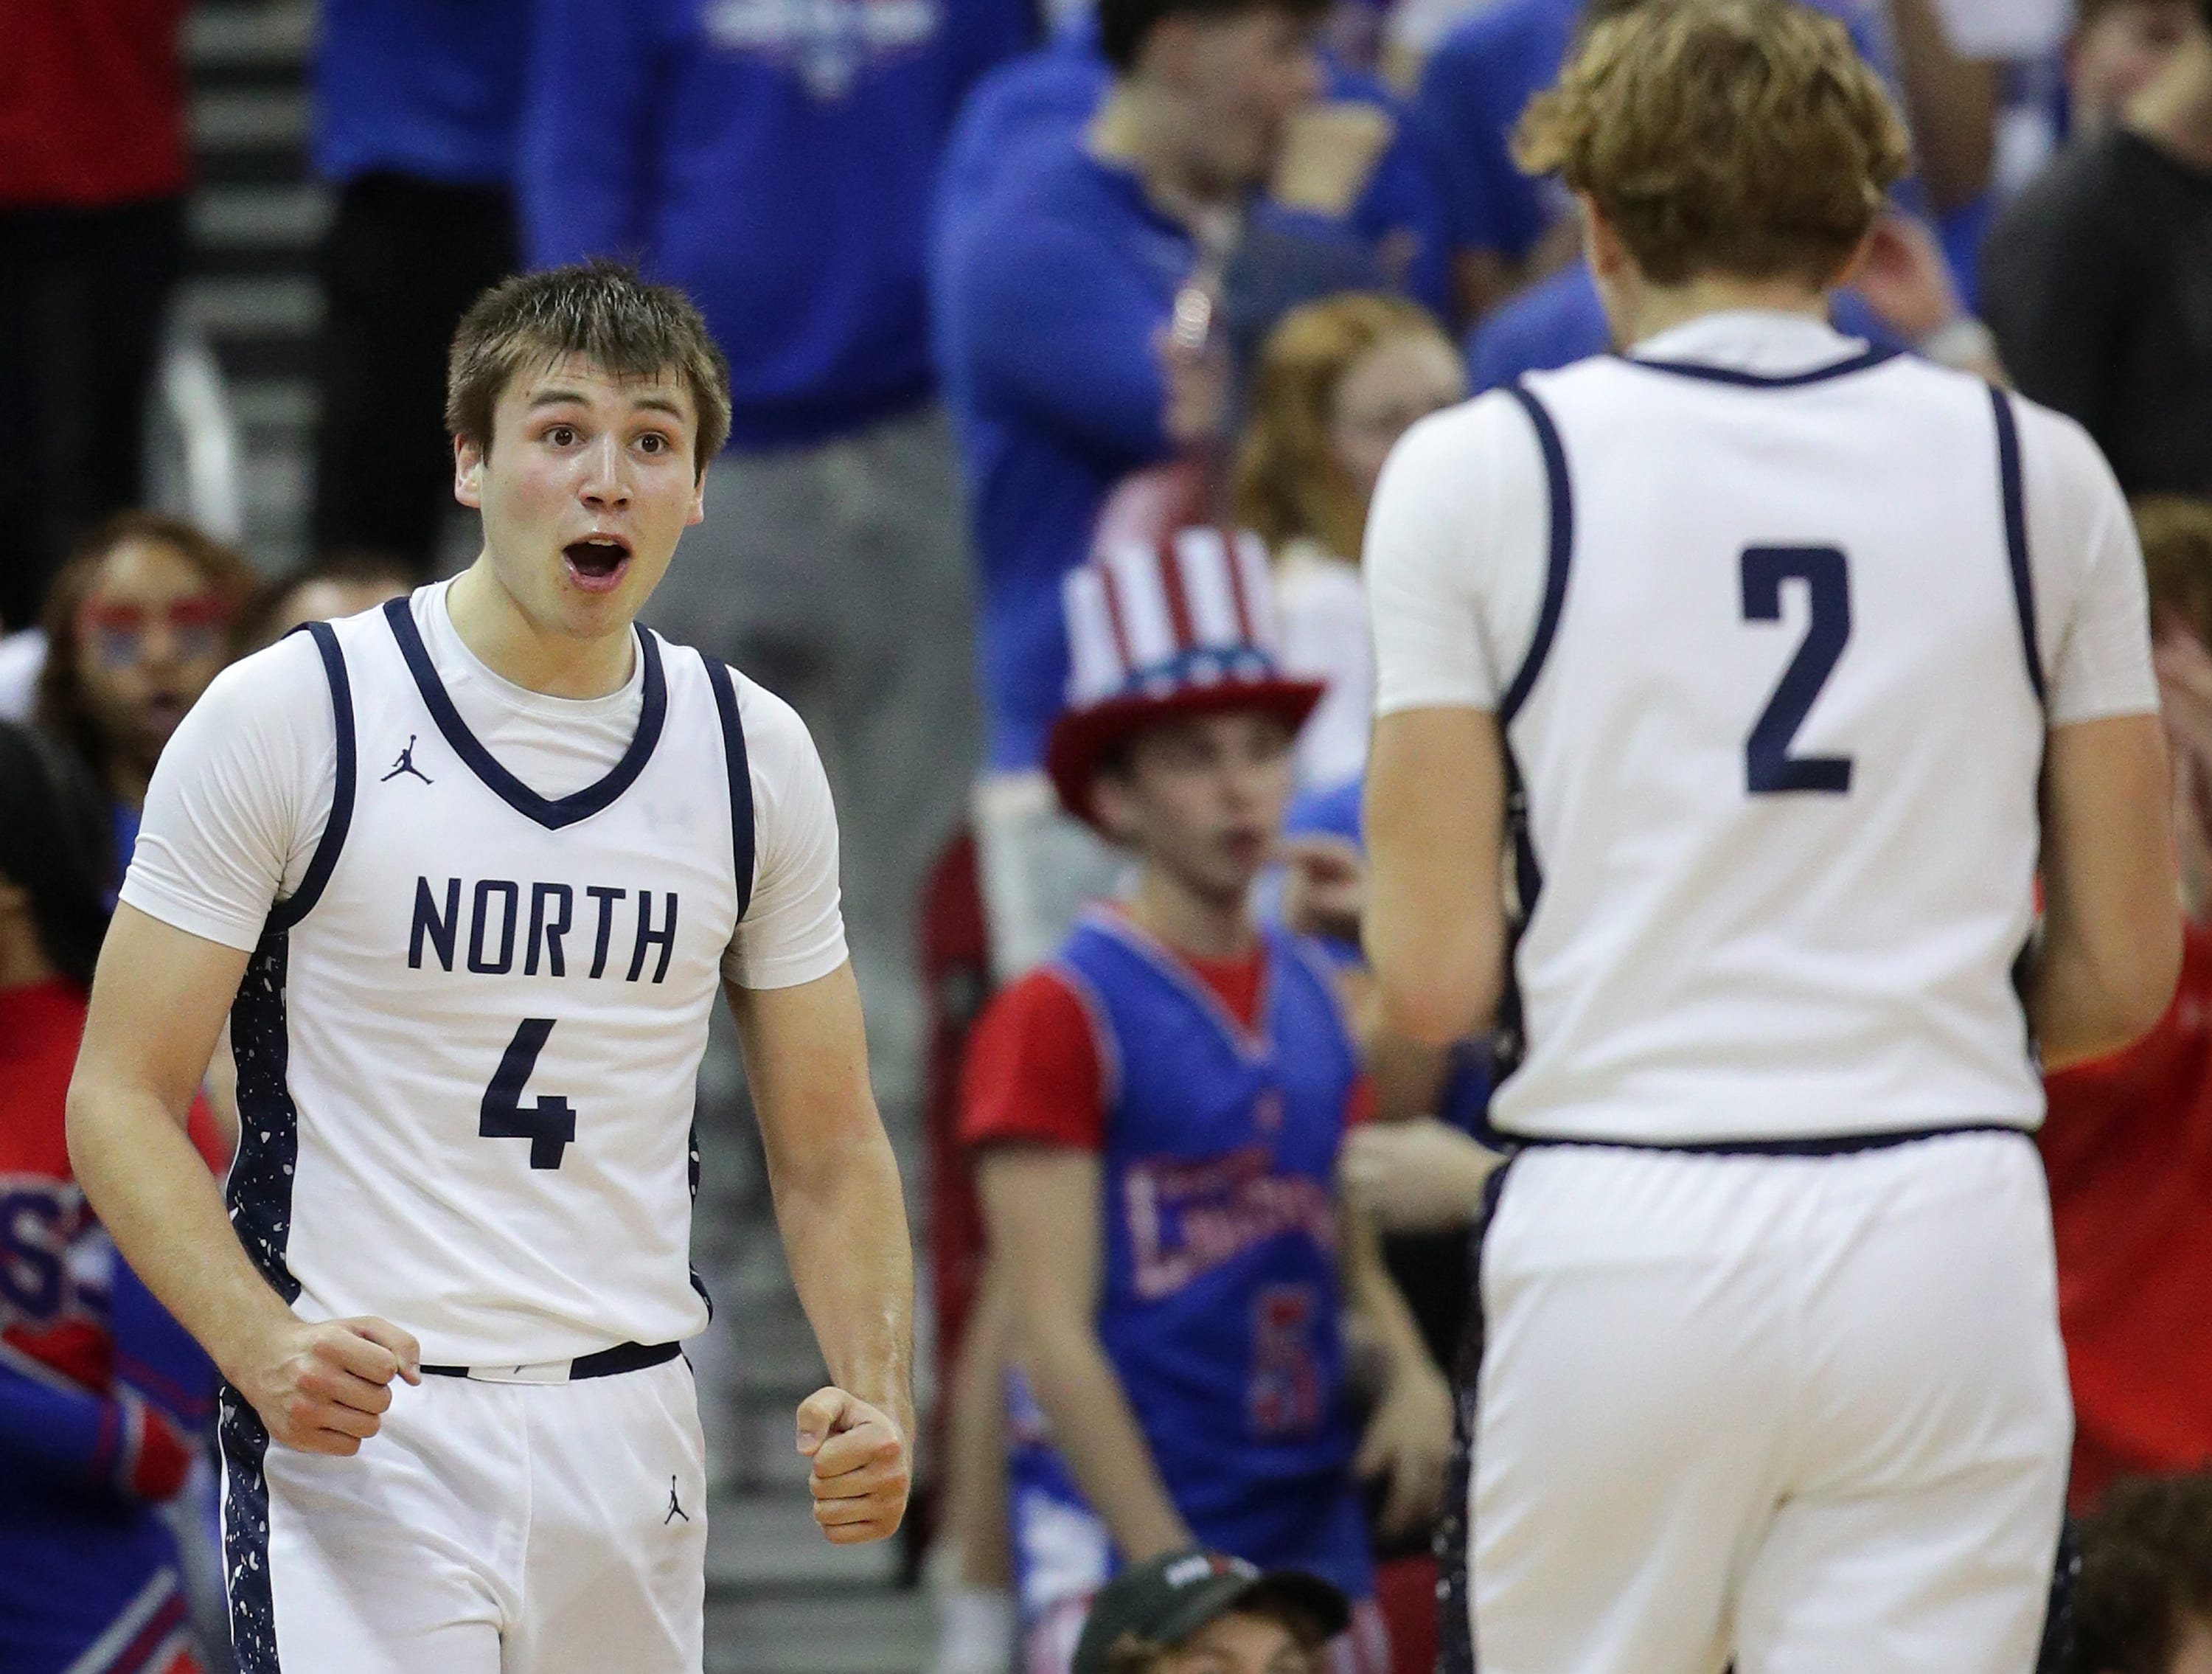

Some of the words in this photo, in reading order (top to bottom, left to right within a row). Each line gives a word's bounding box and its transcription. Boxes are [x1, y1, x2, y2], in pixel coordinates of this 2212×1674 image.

[1740, 546, 1854, 796] 2
[408, 875, 678, 984] NORTH
[478, 1018, 577, 1170] 4
